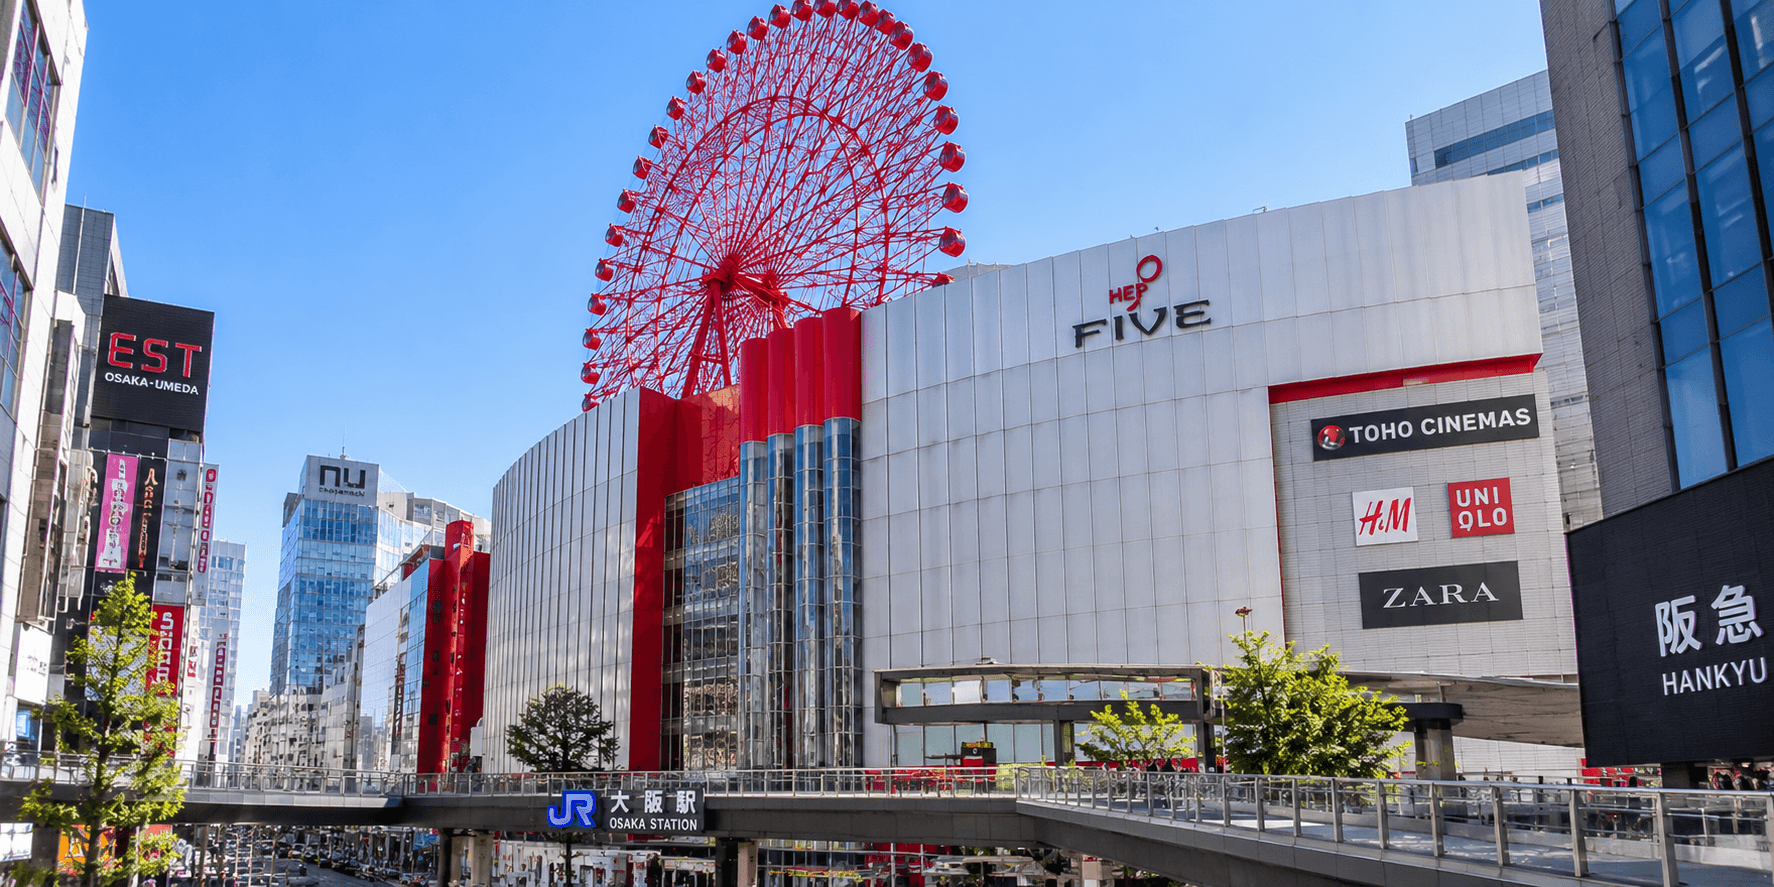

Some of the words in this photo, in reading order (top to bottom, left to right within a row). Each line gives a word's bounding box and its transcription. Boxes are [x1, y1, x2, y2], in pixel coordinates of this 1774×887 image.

[1109, 282, 1149, 312] HEP
[1072, 299, 1212, 348] FIVE
[107, 332, 202, 378] EST
[1349, 420, 1413, 444] TOHO
[1420, 408, 1531, 436] CINEMAS
[320, 465, 366, 489] nu
[1455, 486, 1499, 508] UNI
[1358, 497, 1411, 536] H&M
[1458, 506, 1508, 532] QLO
[1383, 582, 1499, 609] ZARA
[1655, 585, 1764, 657] 阪急
[1662, 657, 1768, 696] HANKYU
[547, 790, 596, 828] JR
[610, 789, 697, 814] 大阪駅
[609, 817, 646, 830] OSAKA
[650, 817, 698, 831] STATION
